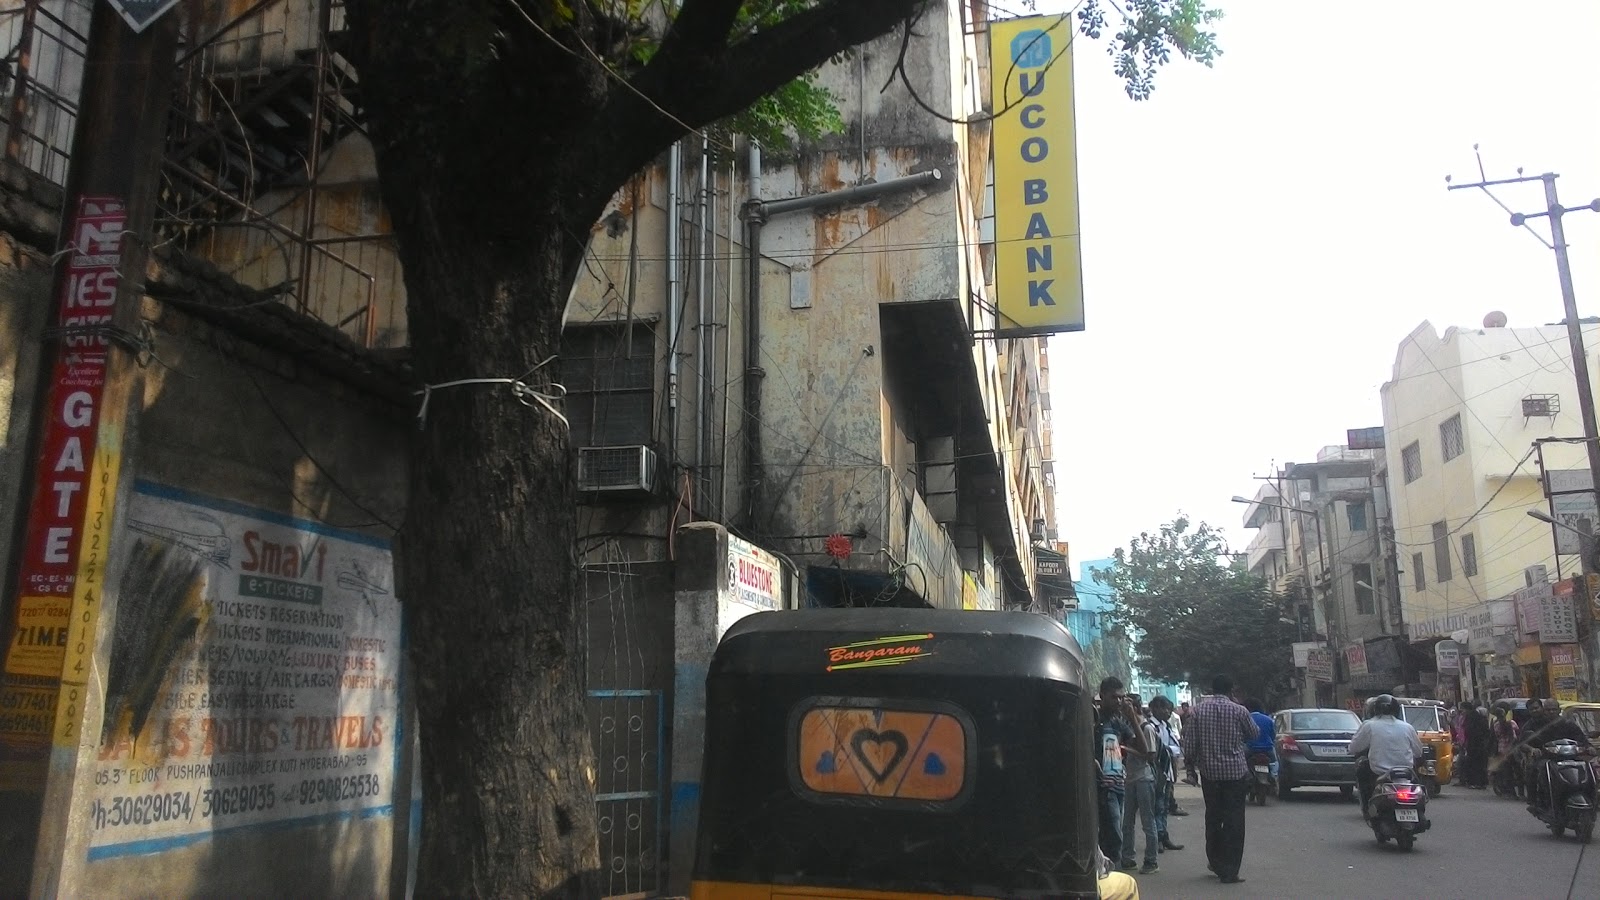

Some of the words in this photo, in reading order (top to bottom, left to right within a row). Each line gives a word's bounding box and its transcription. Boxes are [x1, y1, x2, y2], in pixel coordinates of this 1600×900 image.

[1019, 71, 1049, 162] UCO
[1024, 179, 1056, 307] BANK
[67, 271, 118, 309] IES
[44, 391, 93, 563] GATE
[739, 558, 773, 595] BLUESTONE
[217, 600, 266, 621] TICKETS
[270, 606, 344, 629] RESERVATION
[829, 645, 922, 662] Bangaram
[1551, 655, 1572, 665] XEROX
[292, 714, 383, 751] TRAVELS
[129, 766, 160, 785] FLOOR
